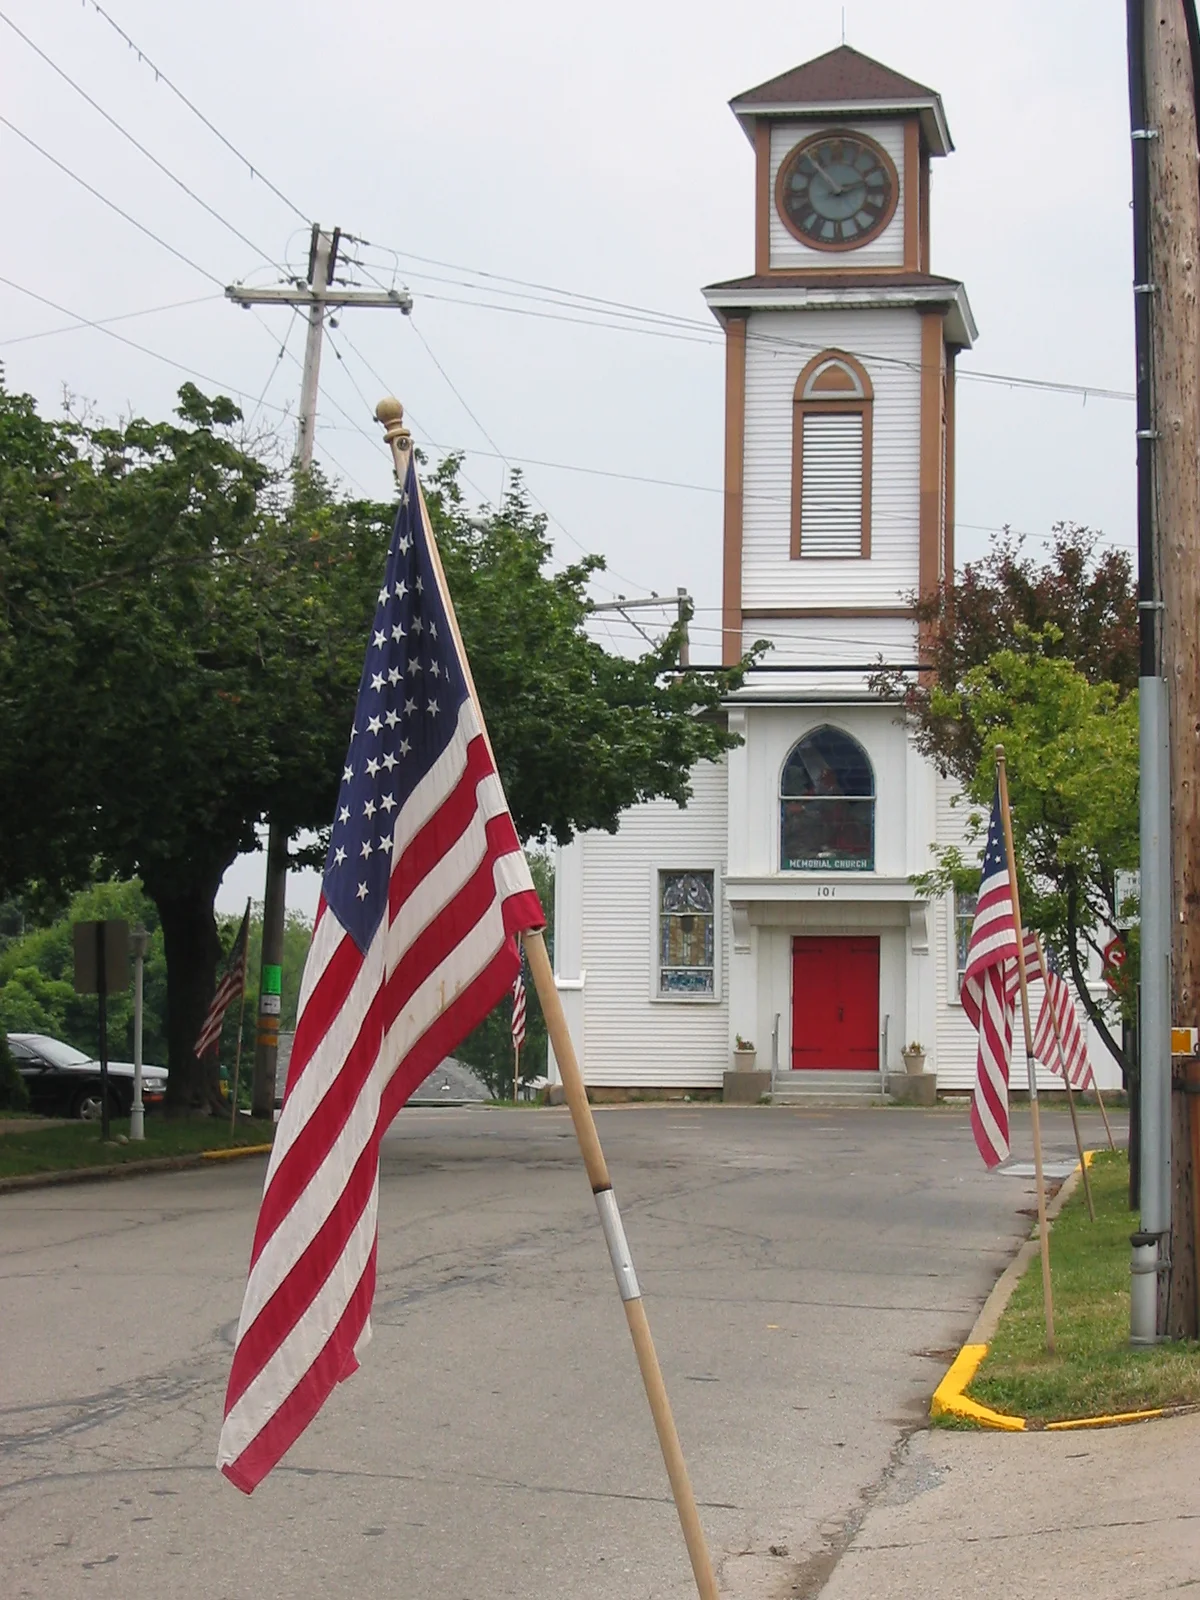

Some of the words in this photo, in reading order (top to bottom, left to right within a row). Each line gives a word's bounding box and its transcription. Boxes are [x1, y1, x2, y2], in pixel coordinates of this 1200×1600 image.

[789, 859, 832, 868] MEMORIAL
[834, 860, 867, 868] CHURCH
[817, 886, 836, 897] 101
